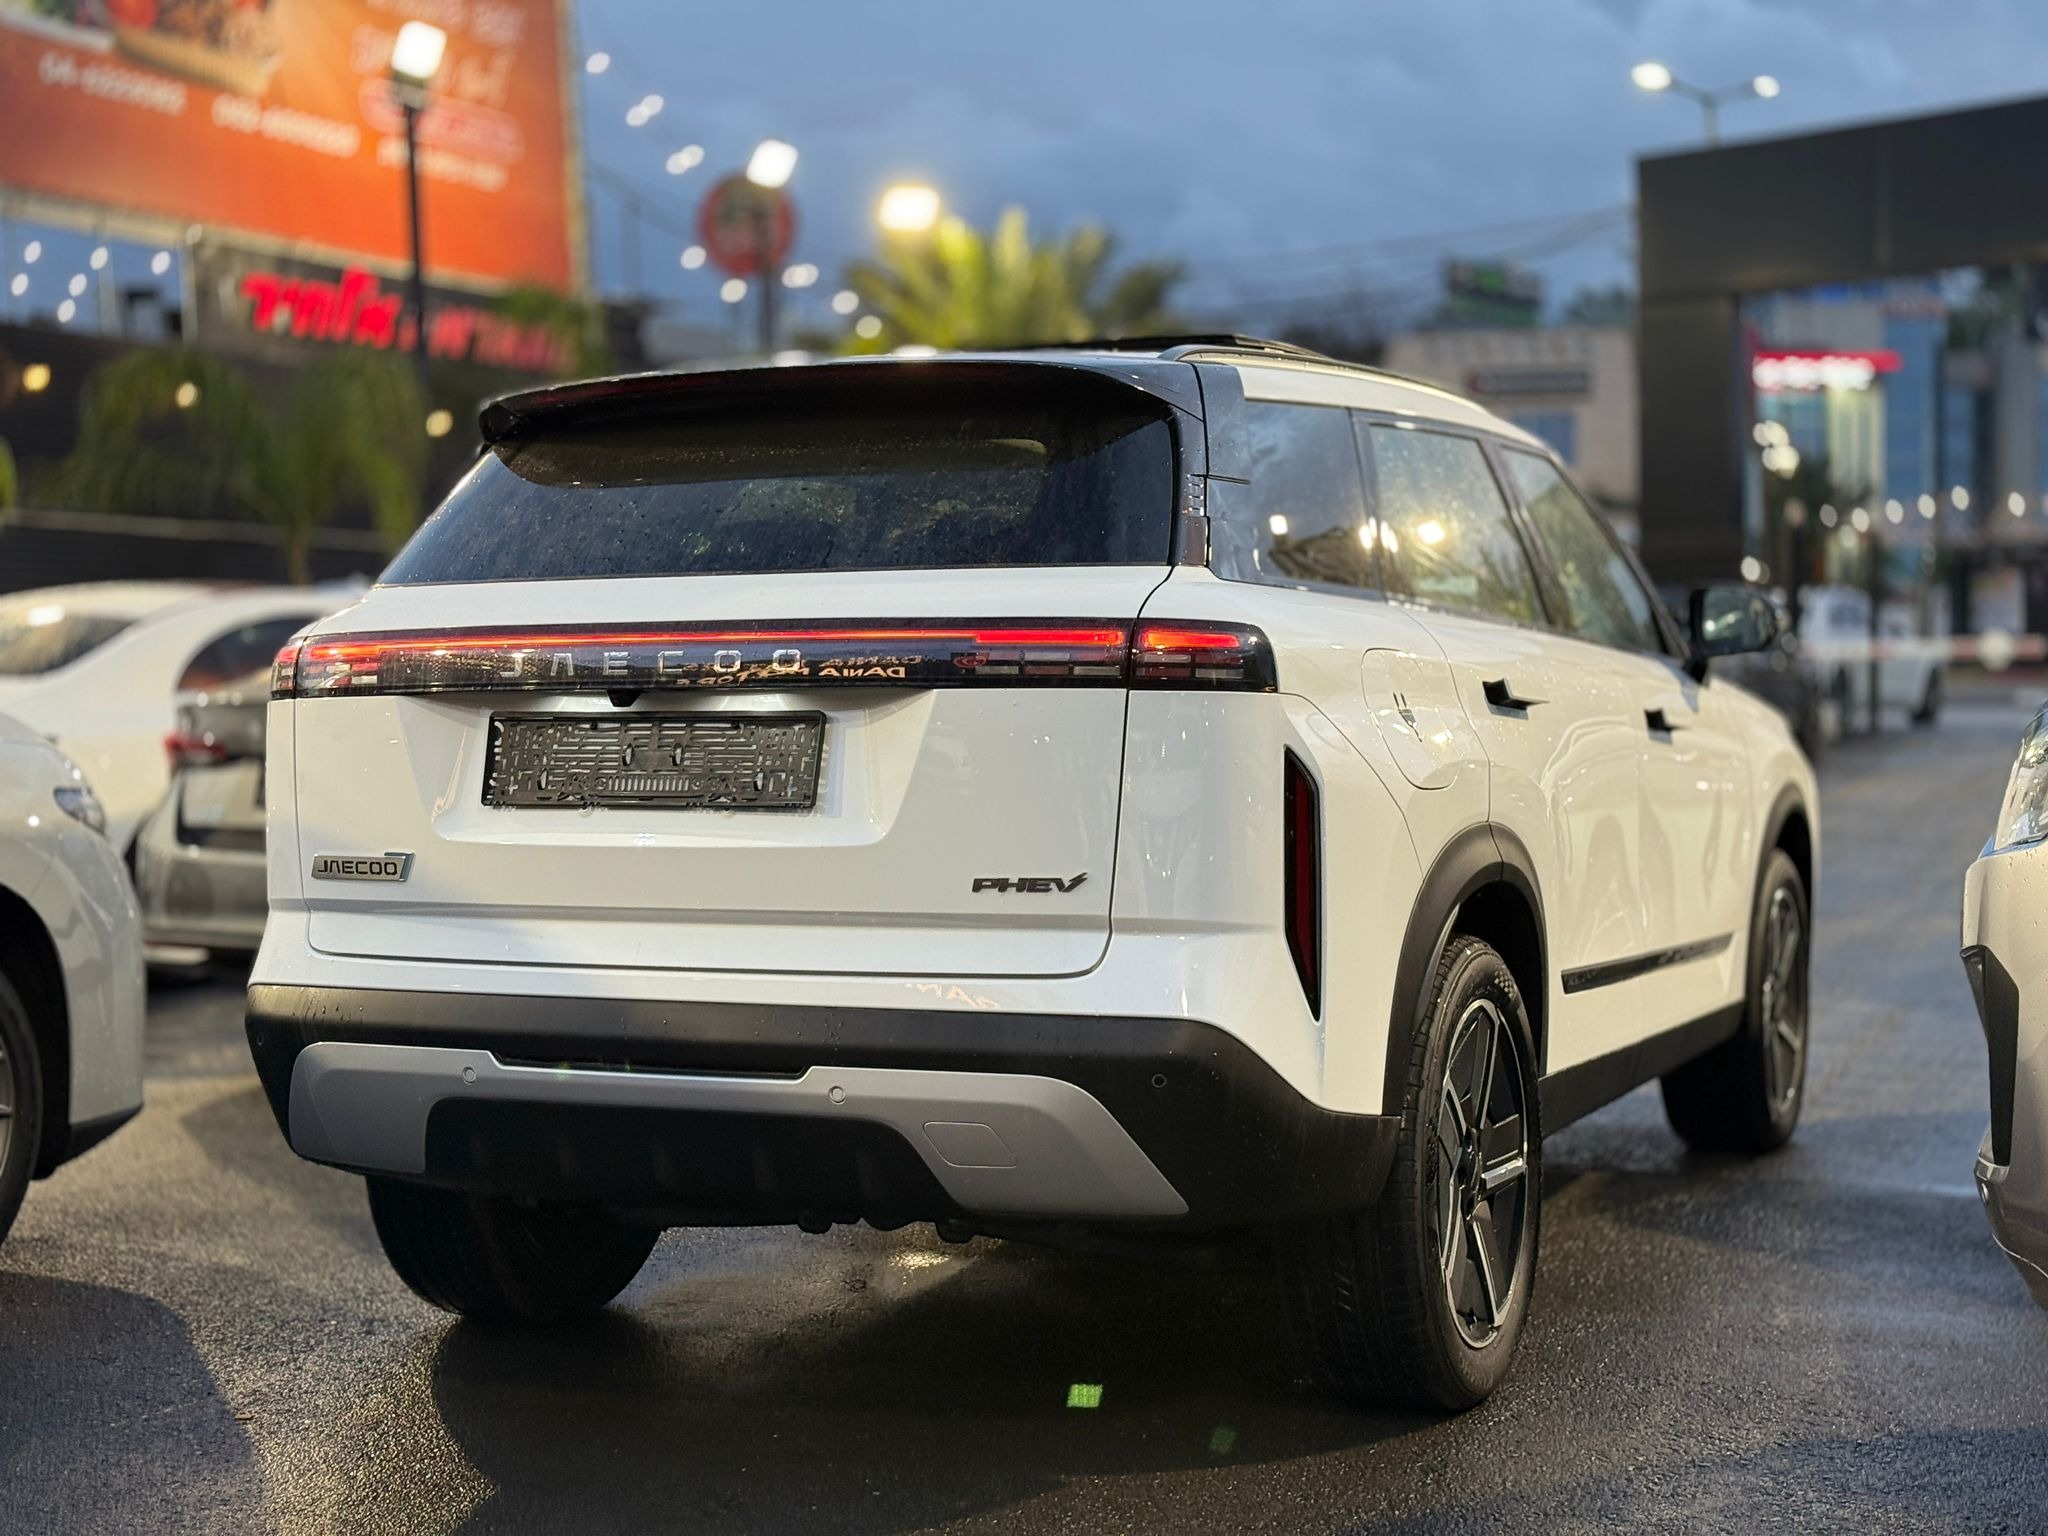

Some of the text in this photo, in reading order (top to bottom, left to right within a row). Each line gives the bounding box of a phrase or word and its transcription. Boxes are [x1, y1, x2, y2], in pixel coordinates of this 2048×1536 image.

[499, 649, 802, 678] JAECOO
[317, 859, 398, 875] JAECOO
[971, 872, 1089, 893] PHEV
